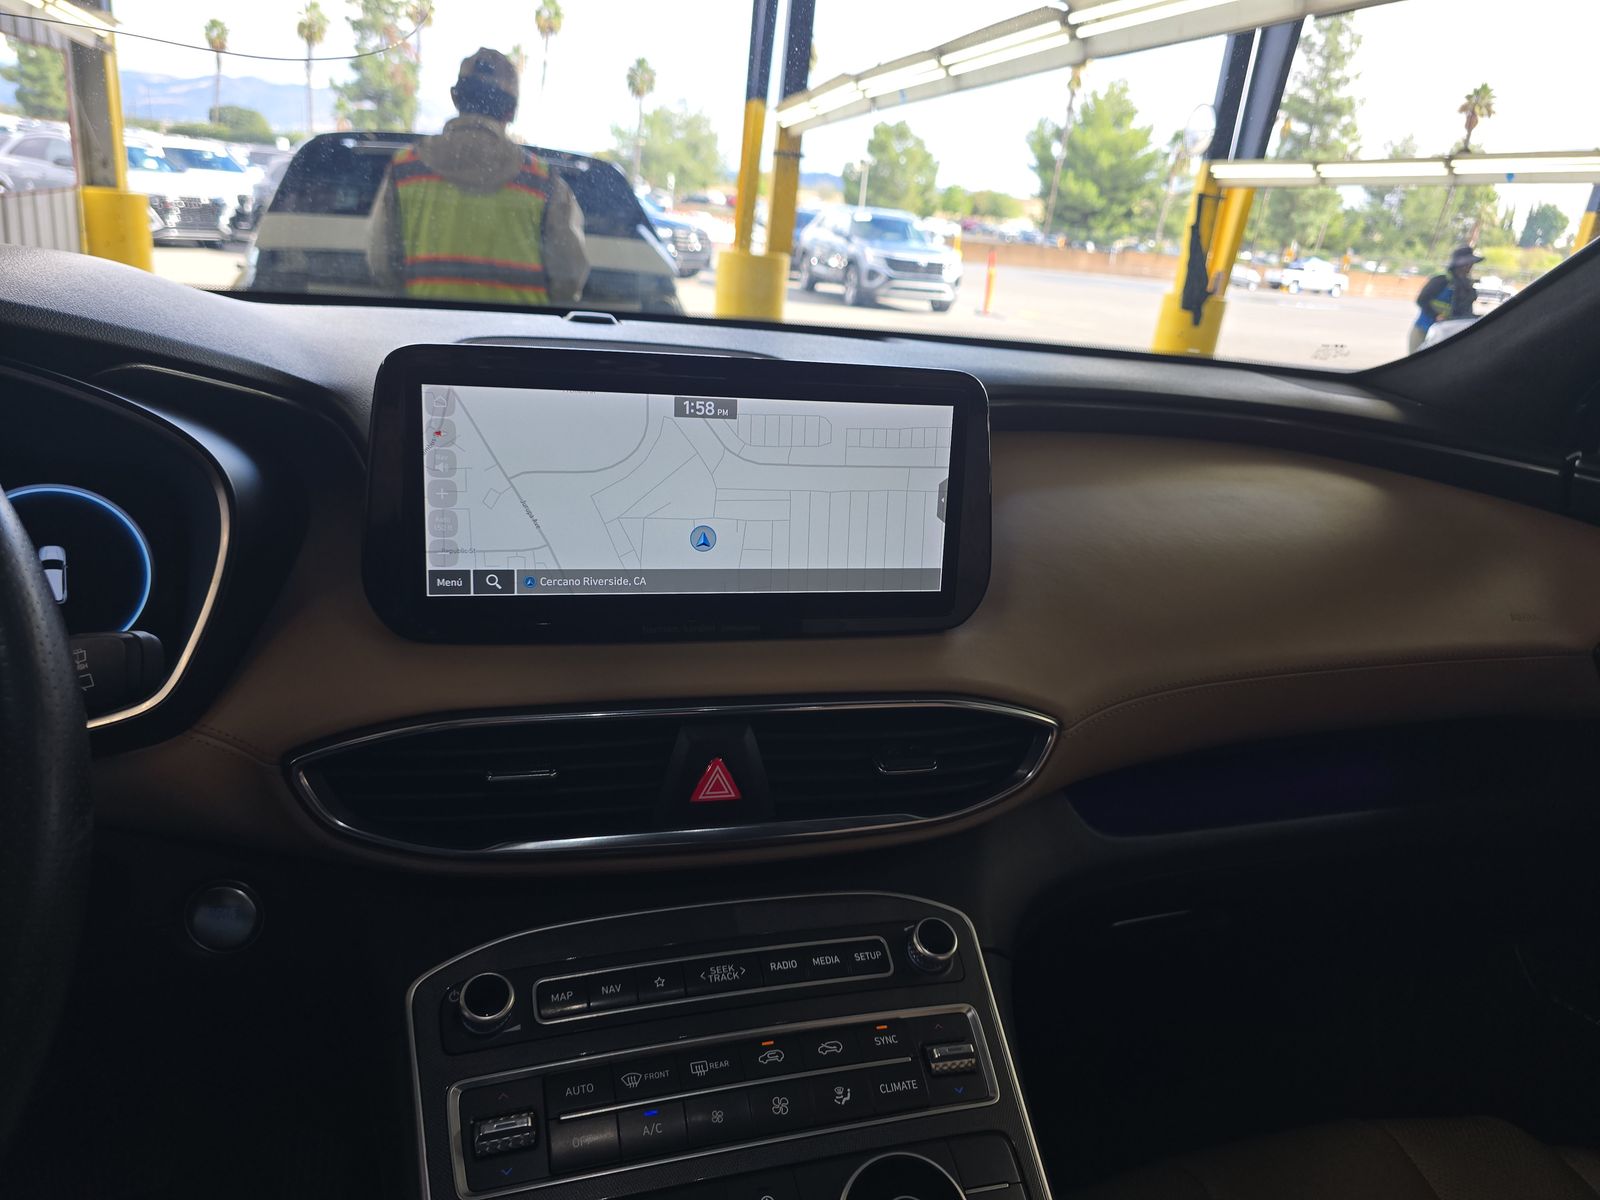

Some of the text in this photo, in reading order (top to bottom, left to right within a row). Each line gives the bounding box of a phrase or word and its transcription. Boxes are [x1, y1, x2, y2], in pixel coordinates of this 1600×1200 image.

[683, 400, 729, 416] 1:58 PM
[436, 577, 463, 587] Menú
[539, 576, 647, 587] Cercano Riverside, CA
[812, 955, 841, 967] MEDIA
[854, 951, 882, 962] SETUP
[709, 964, 735, 975] SEEK
[770, 959, 798, 971] RADIO
[707, 971, 740, 983] TRACK
[601, 984, 622, 995] NAV
[551, 991, 574, 1003] MAP
[874, 1034, 899, 1046] SYNC
[709, 1060, 730, 1070] REAR
[644, 1069, 670, 1081] FRONT
[565, 1083, 594, 1097] AUTO
[879, 1079, 918, 1094] CLIMATE
[642, 1122, 663, 1137] A/C
